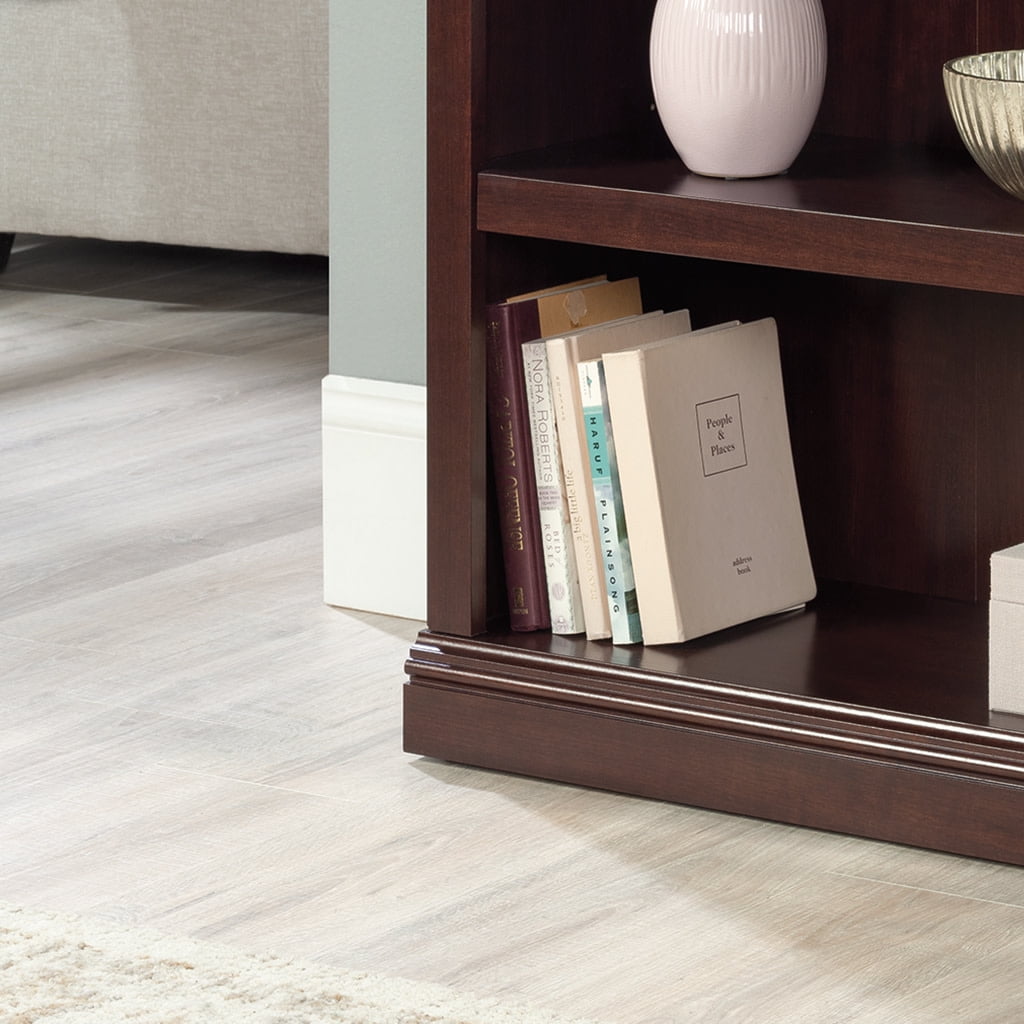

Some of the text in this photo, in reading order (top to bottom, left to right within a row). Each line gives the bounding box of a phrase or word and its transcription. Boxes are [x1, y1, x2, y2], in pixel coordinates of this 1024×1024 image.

[531, 359, 546, 404] NORA
[706, 414, 733, 429] People
[537, 409, 553, 483] ROBERTS
[590, 417, 603, 475] HARUF
[717, 430, 725, 440] &
[710, 442, 736, 456] Places
[567, 488, 579, 514] little
[570, 515, 582, 534] big
[544, 524, 554, 568] ROSES
[600, 499, 620, 613] PLAINSONG
[732, 555, 752, 567] address
[737, 566, 751, 575] book
